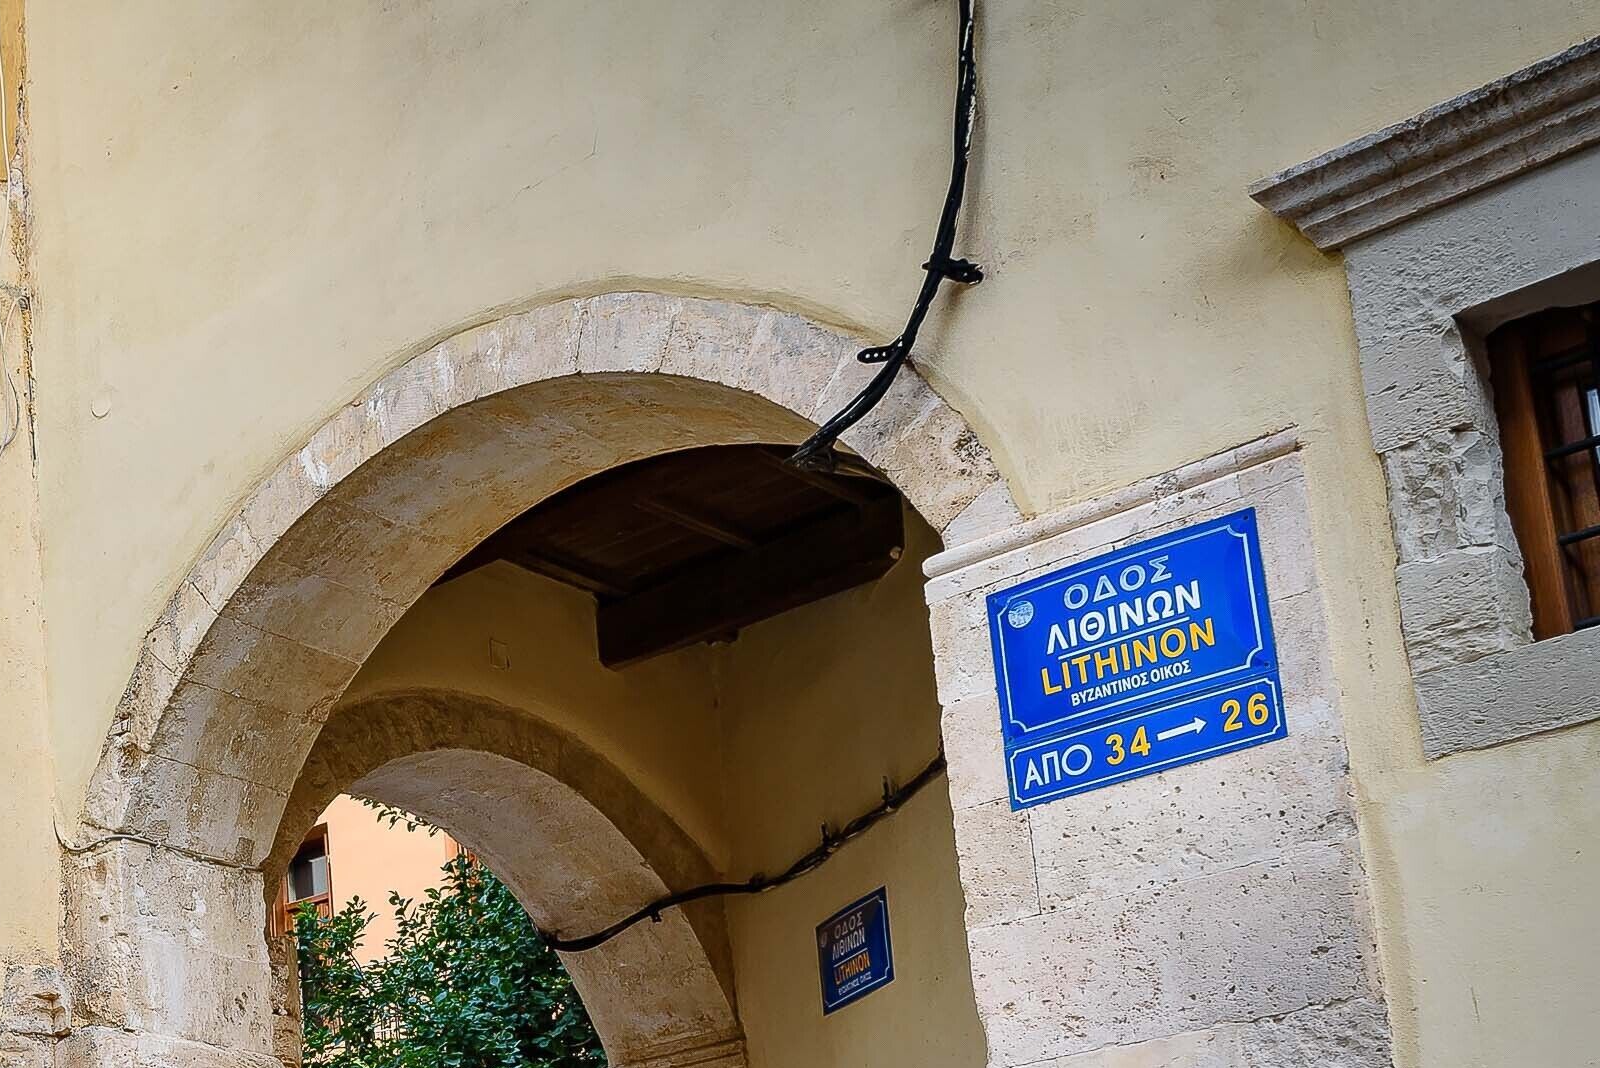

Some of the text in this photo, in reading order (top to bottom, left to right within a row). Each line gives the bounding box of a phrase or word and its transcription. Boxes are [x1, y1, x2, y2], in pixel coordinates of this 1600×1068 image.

[1063, 555, 1172, 610] ΟΔΟΣ
[1046, 580, 1202, 655] ΛΙΘΙΝΩΝ
[1041, 617, 1216, 696] LITHINON
[1071, 660, 1191, 706] ΒΥΖΑΝΤΙΝΟΣ ΟΙΚΟΣ
[1023, 693, 1269, 790] ΑΠΟ 34 26
[834, 912, 863, 939] ΟΔΟΣ
[834, 951, 870, 985] LITHINON
